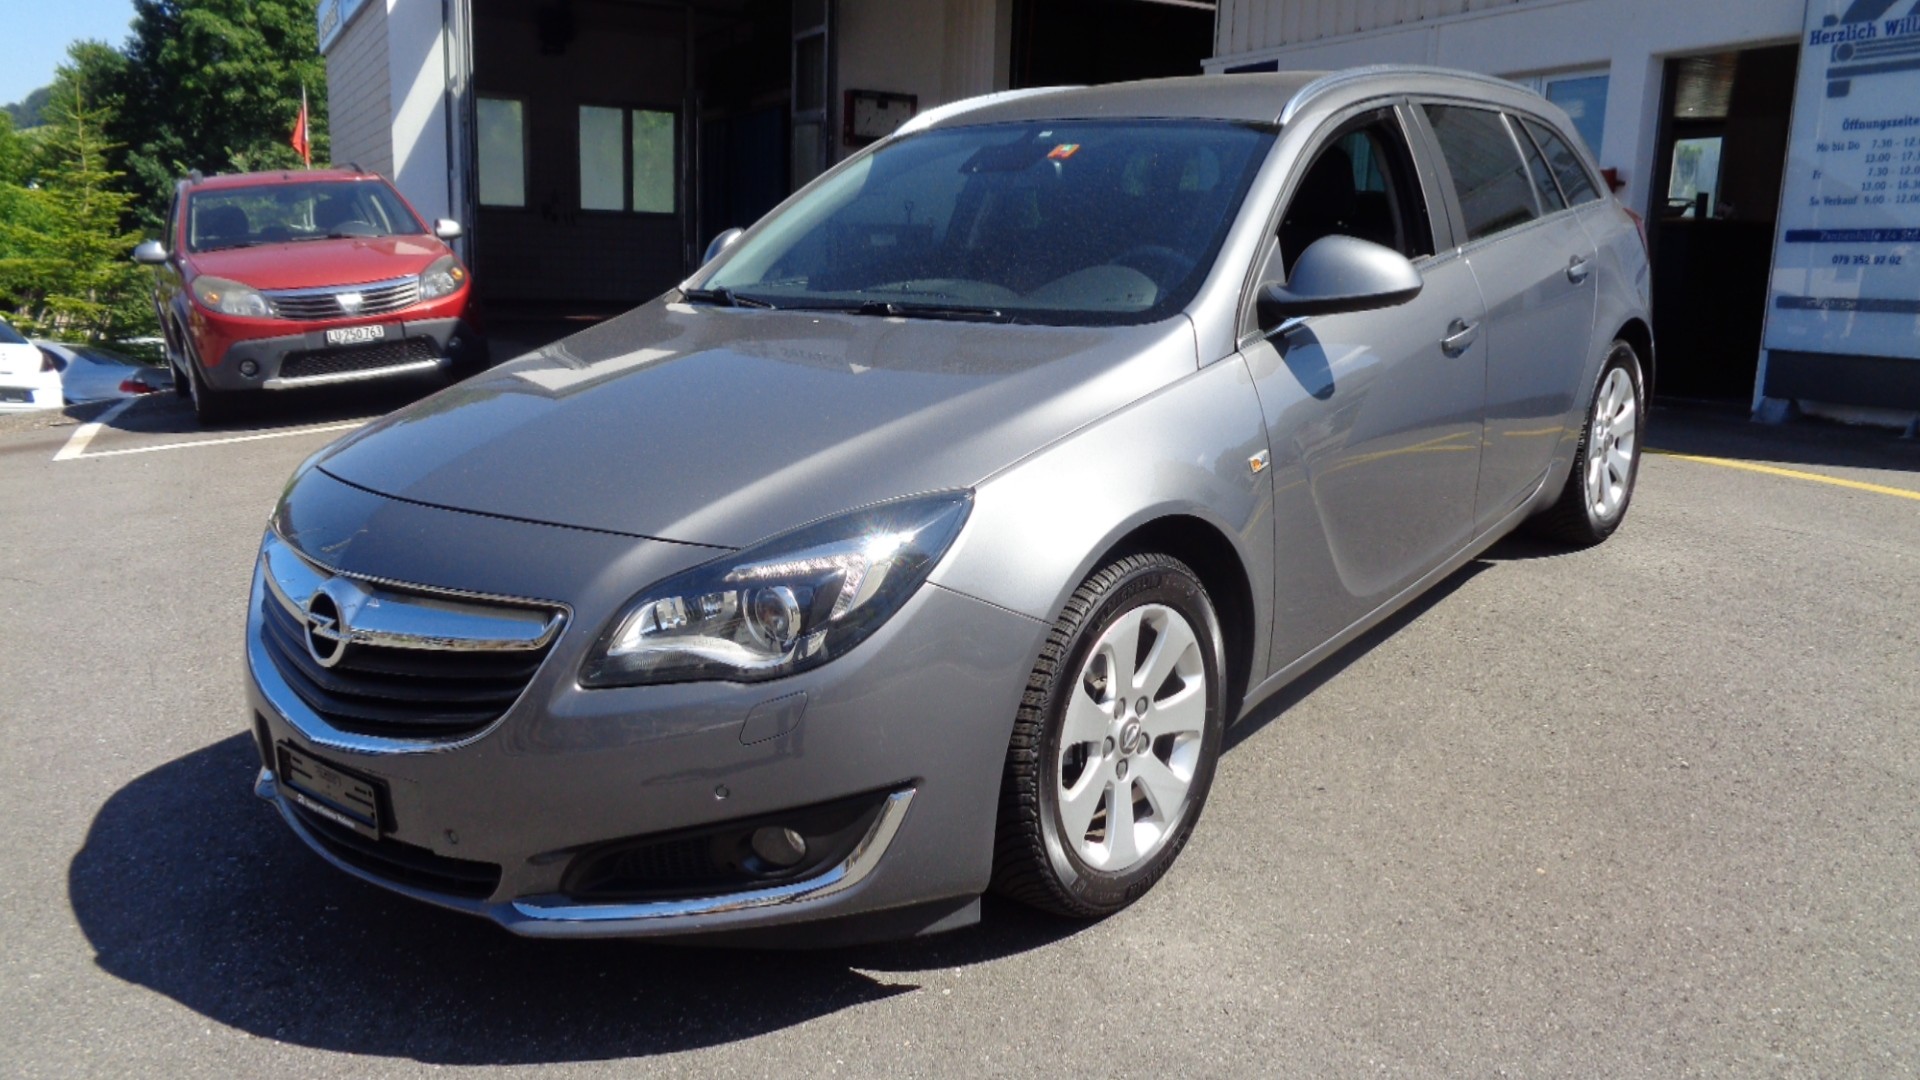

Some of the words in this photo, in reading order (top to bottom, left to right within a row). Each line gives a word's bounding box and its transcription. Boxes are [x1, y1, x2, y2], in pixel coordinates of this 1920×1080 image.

[1810, 22, 1877, 46] Herzlich
[1885, 15, 1920, 37] Will
[1848, 140, 1860, 150] Do
[1872, 138, 1893, 149] 7.30
[1865, 152, 1891, 163] 13.00
